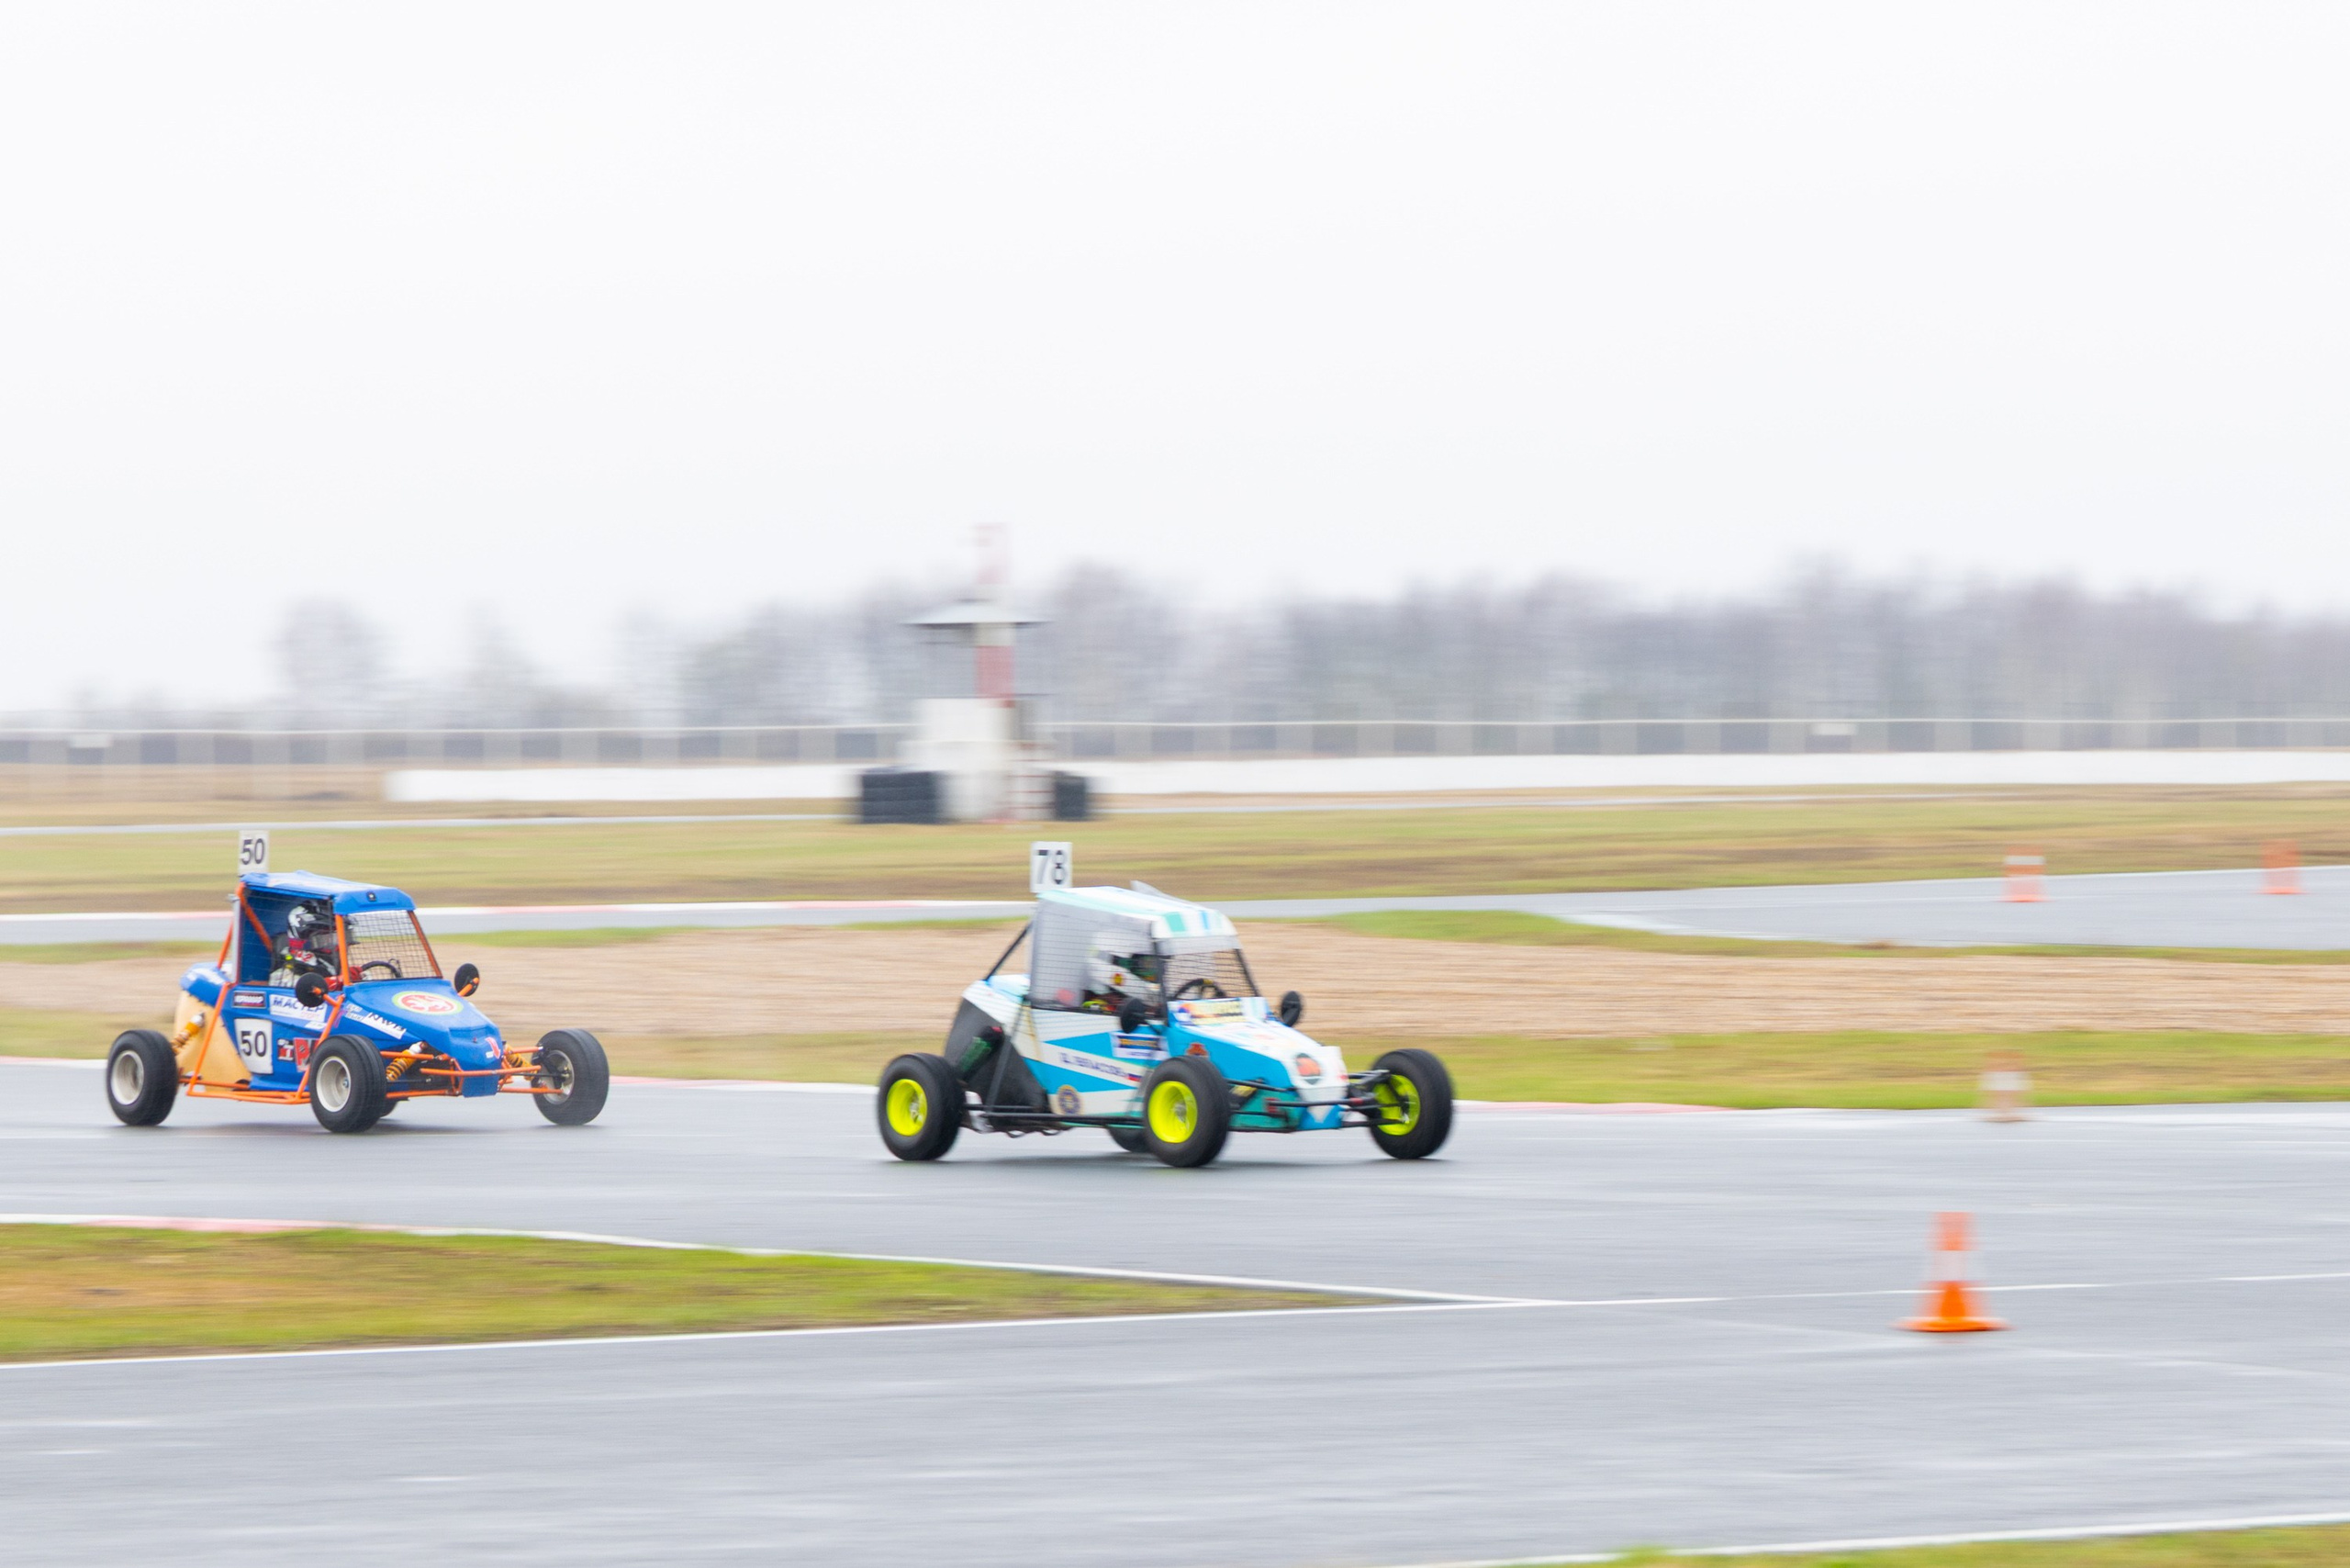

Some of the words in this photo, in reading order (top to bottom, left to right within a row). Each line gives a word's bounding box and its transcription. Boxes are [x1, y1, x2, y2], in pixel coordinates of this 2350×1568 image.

[241, 838, 265, 866] 50
[1035, 849, 1069, 885] 78
[241, 1030, 268, 1058] 50
